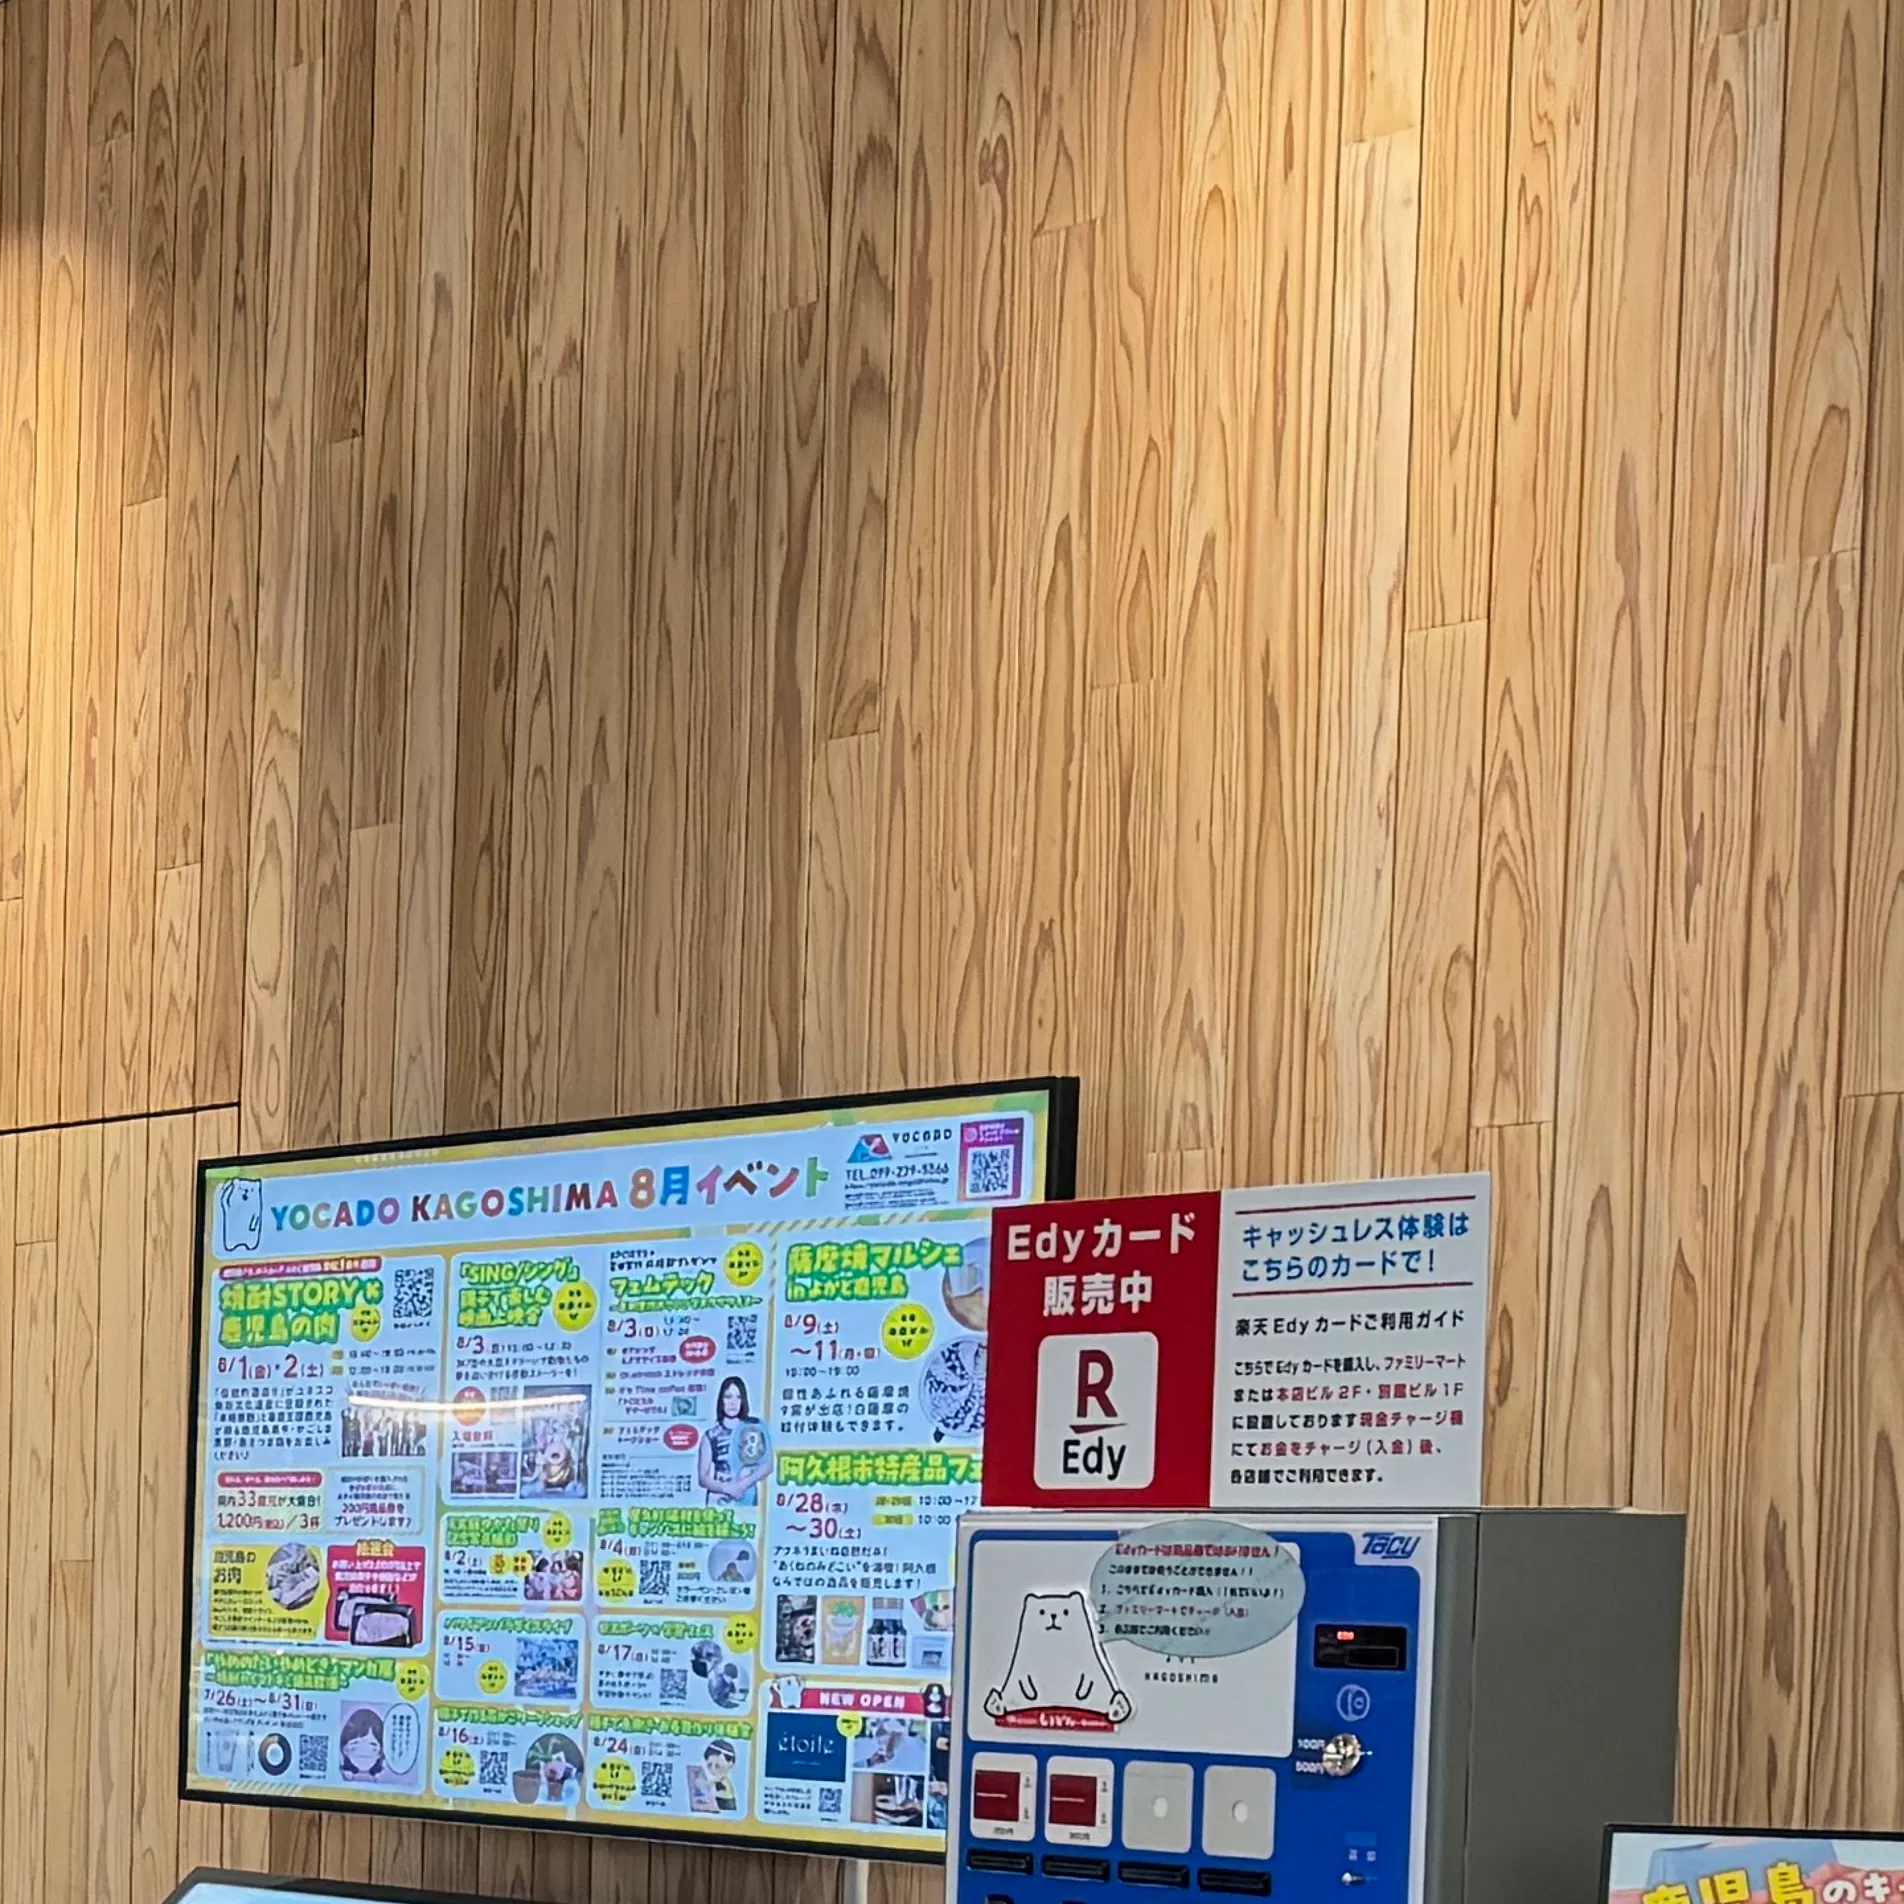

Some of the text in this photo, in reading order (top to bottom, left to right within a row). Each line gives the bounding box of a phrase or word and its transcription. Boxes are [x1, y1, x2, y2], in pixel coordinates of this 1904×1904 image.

[271, 1197, 400, 1231] YOCADO
[411, 1180, 620, 1223] KAGOSHIMA
[629, 1156, 830, 1209] 8月イベント
[1007, 1211, 1197, 1264] Edyカード
[1241, 1211, 1470, 1251] キャッシュレス体験は
[788, 1240, 964, 1274] 薩摩焼マルシェ
[610, 1270, 715, 1297] フェムテック
[1042, 1271, 1153, 1317] 販売中
[1061, 1437, 1128, 1481] Edy
[819, 1691, 906, 1709] NEW OPEN
[778, 1731, 834, 1754] étoile
